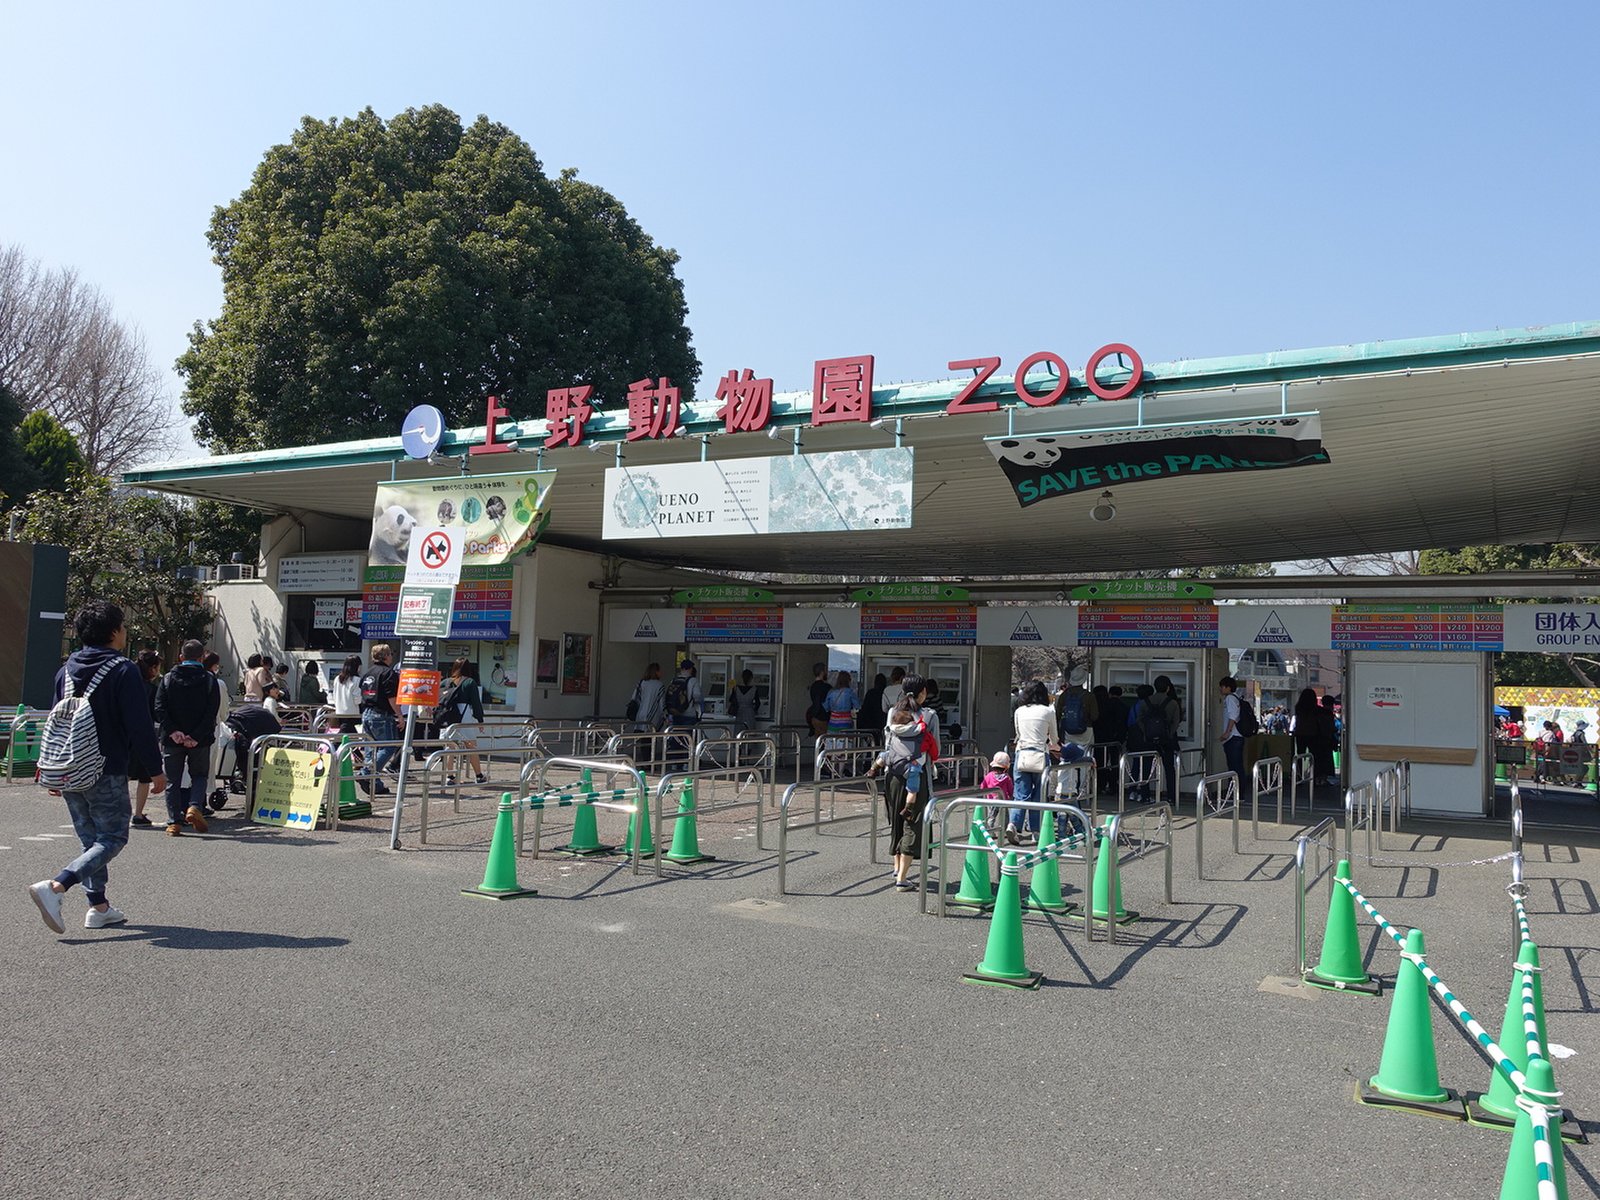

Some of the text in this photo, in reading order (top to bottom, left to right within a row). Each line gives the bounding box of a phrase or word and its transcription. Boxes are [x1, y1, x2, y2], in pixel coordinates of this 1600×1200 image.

[469, 342, 1144, 455] 上野動物園 ZOO
[1017, 466, 1102, 502] SAVE
[1103, 460, 1162, 482] the
[659, 493, 699, 505] UENO
[658, 510, 715, 525] PLANET
[697, 588, 749, 596] チケット販売機
[878, 585, 940, 594] チケット販売機
[1104, 582, 1177, 592] チケット販売機
[1535, 611, 1600, 632] 団体入
[1536, 633, 1581, 645] GROUP
